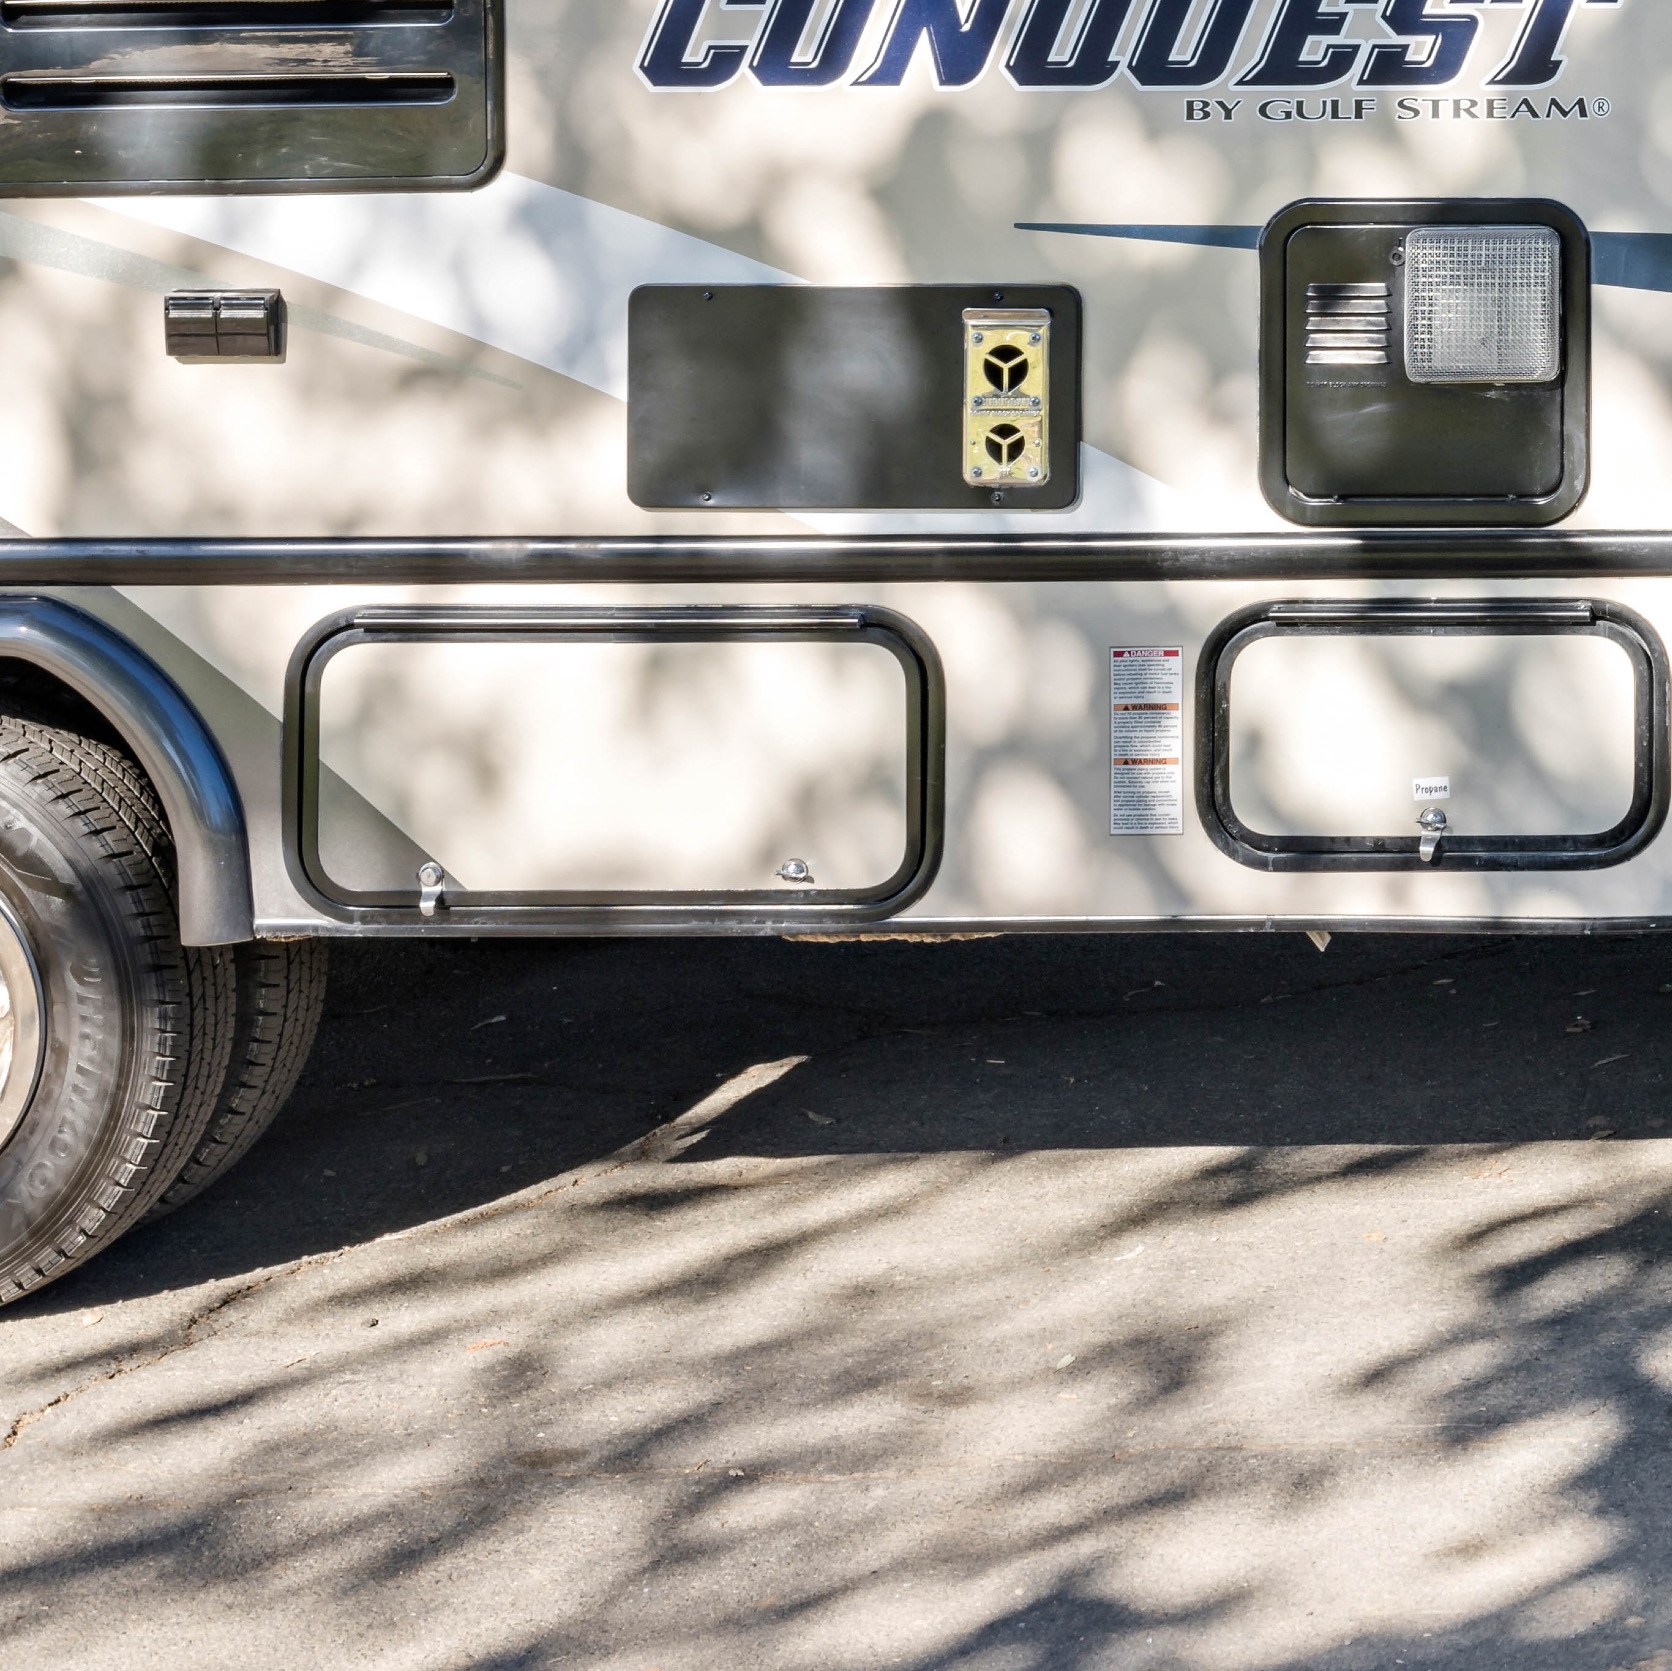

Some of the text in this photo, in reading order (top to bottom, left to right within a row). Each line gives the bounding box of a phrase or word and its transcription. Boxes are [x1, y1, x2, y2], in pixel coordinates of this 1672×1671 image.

[1184, 98, 1242, 120] BY
[1257, 98, 1375, 120] GULF
[1415, 784, 1448, 796] Propane
